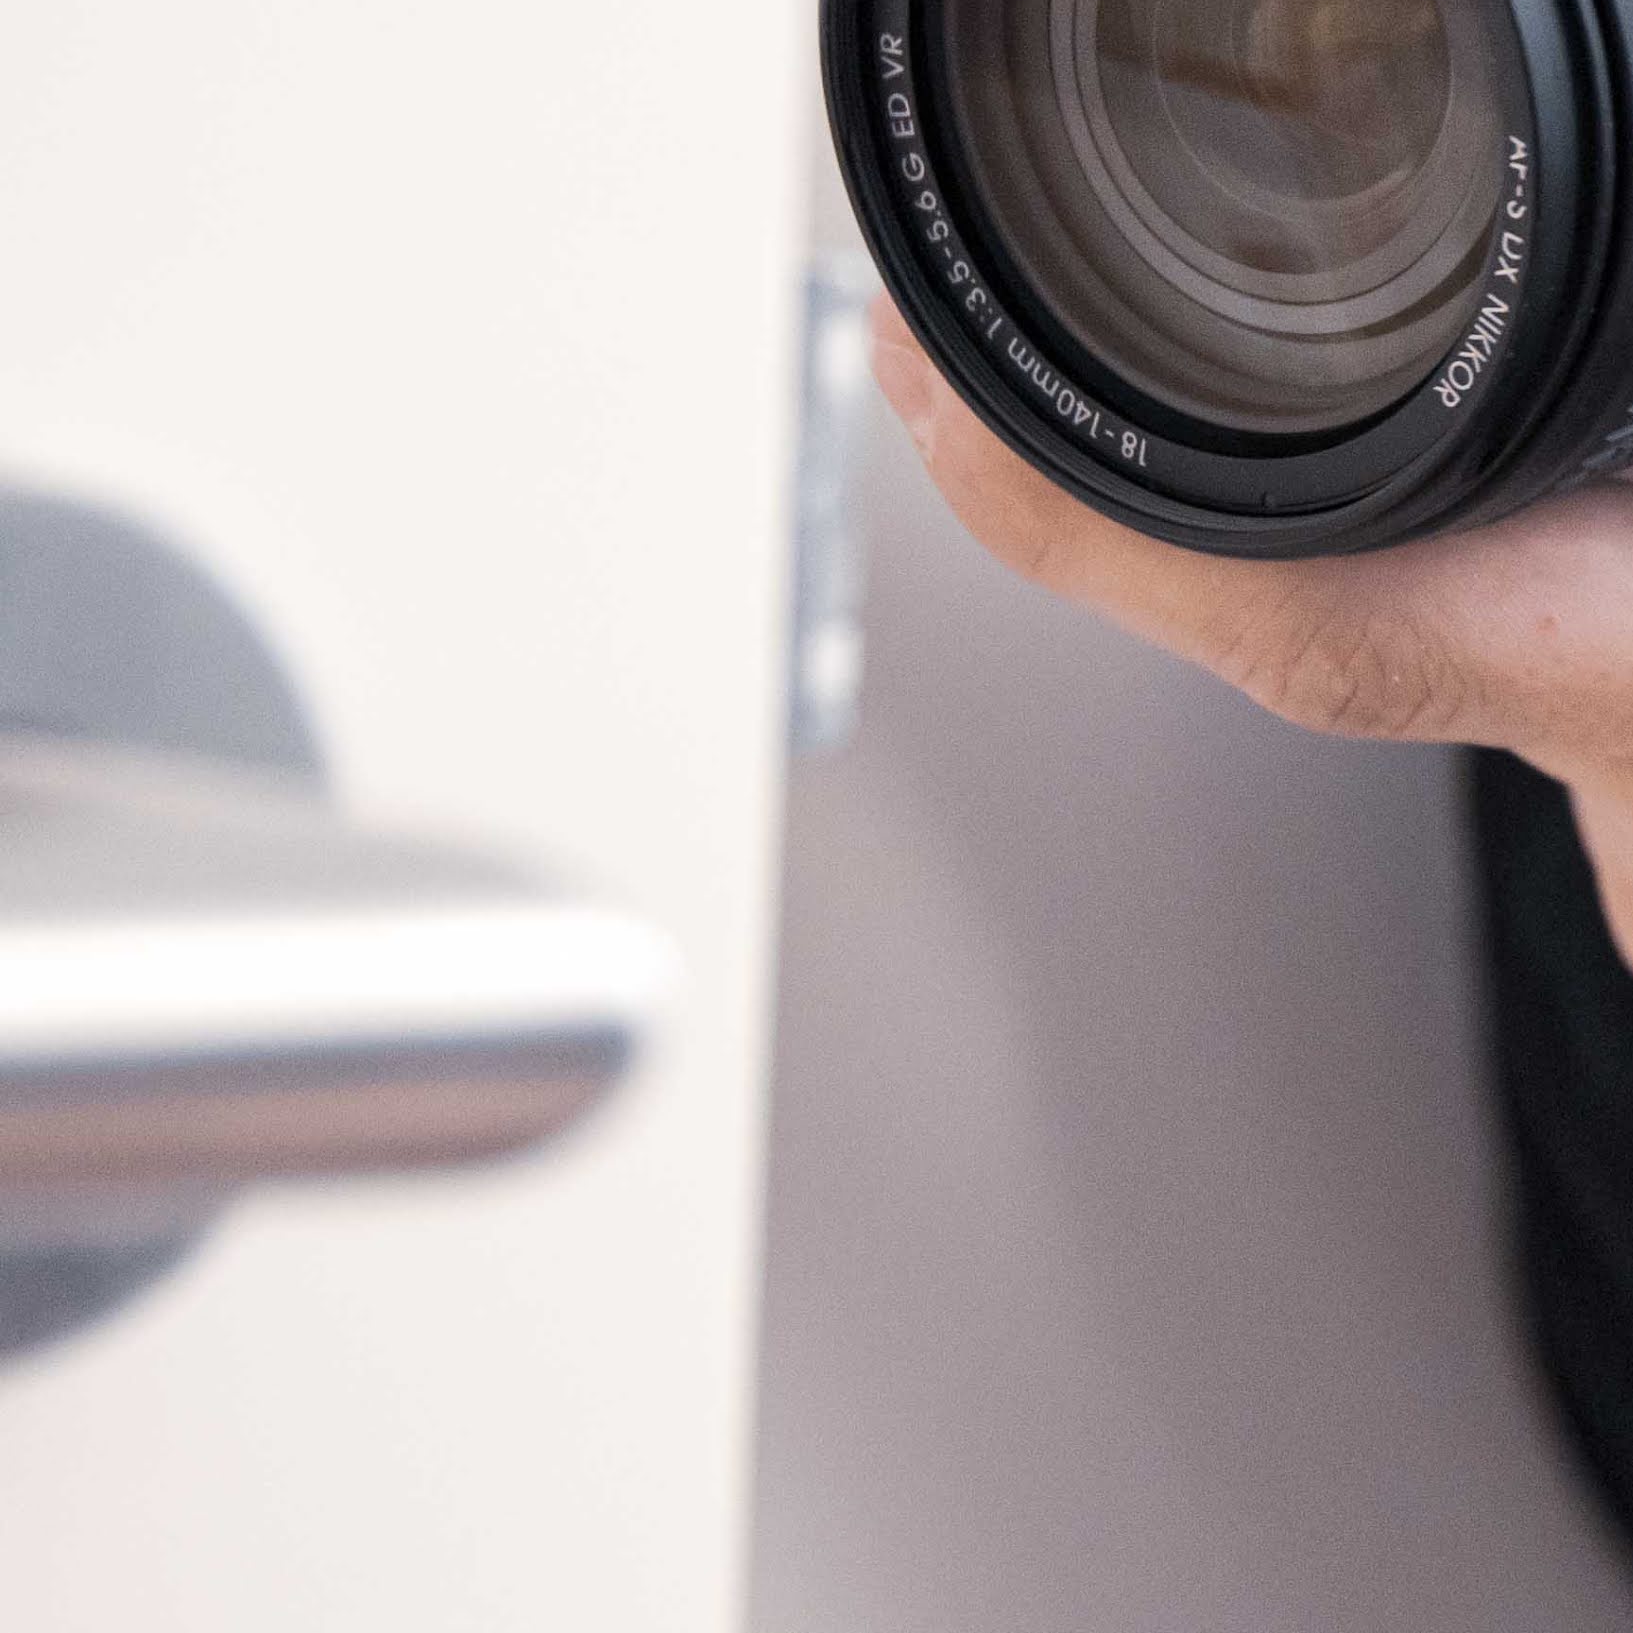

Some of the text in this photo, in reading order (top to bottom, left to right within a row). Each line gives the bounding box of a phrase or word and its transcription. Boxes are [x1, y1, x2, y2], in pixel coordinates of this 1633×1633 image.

[880, 31, 906, 81] VR
[887, 92, 916, 139] ED
[1433, 292, 1510, 408] NIKKOR
[1007, 336, 1148, 468] 18-140mm
